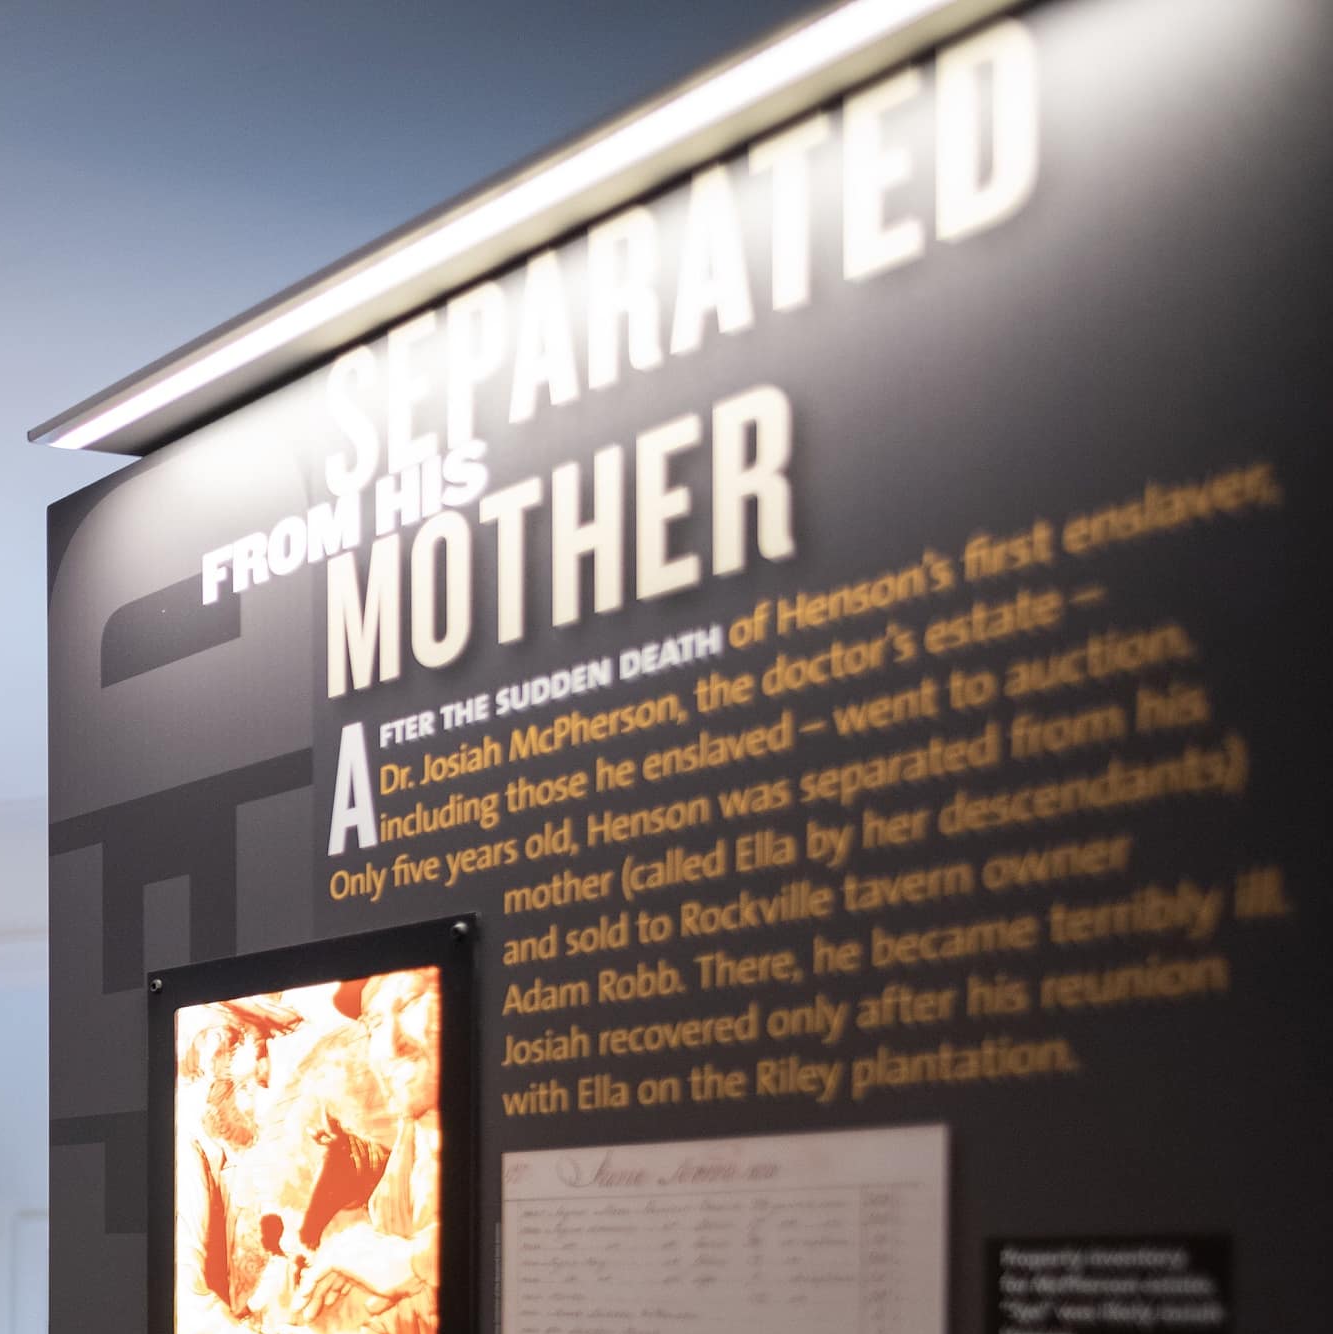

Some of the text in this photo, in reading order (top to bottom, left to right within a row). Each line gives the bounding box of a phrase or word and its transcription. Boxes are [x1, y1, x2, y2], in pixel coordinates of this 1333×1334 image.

[322, 14, 1044, 499] SEPARATED
[202, 439, 489, 605] FROM HIS
[326, 384, 797, 699] MOTHER
[327, 721, 378, 857] A
[379, 711, 434, 749] FTER
[440, 693, 489, 732] THE
[495, 658, 613, 716] SUDDEN
[620, 624, 723, 681] DEATH
[728, 598, 772, 651] of
[776, 549, 956, 636] Henson's
[963, 519, 1056, 583] first
[379, 585, 1066, 796] Dr. Josiah McPherson, the doctor's estate
[379, 790, 499, 842] including
[506, 770, 588, 813] those
[596, 757, 634, 793] he
[642, 711, 791, 781] enslaved
[832, 675, 940, 737] went
[948, 667, 999, 710] to
[329, 684, 1212, 902] Only five years old, Henson was separated from his
[503, 870, 614, 915] mother
[620, 836, 727, 902] (called
[735, 828, 798, 873] Ella
[805, 819, 855, 867] by
[861, 806, 932, 850] her
[502, 833, 1134, 966] and sold to Rockville tavern owner
[502, 978, 591, 1017] Adam
[597, 958, 688, 1003] Robb.
[693, 949, 805, 990] There,
[811, 934, 864, 975] he
[871, 915, 1040, 969] became
[501, 954, 1231, 1067] Josiah recovered only after his reunion
[502, 1078, 569, 1117] with
[576, 1072, 631, 1110] Ella
[637, 1074, 682, 1106] on
[689, 1062, 747, 1101] the
[755, 1057, 845, 1103] Riley
